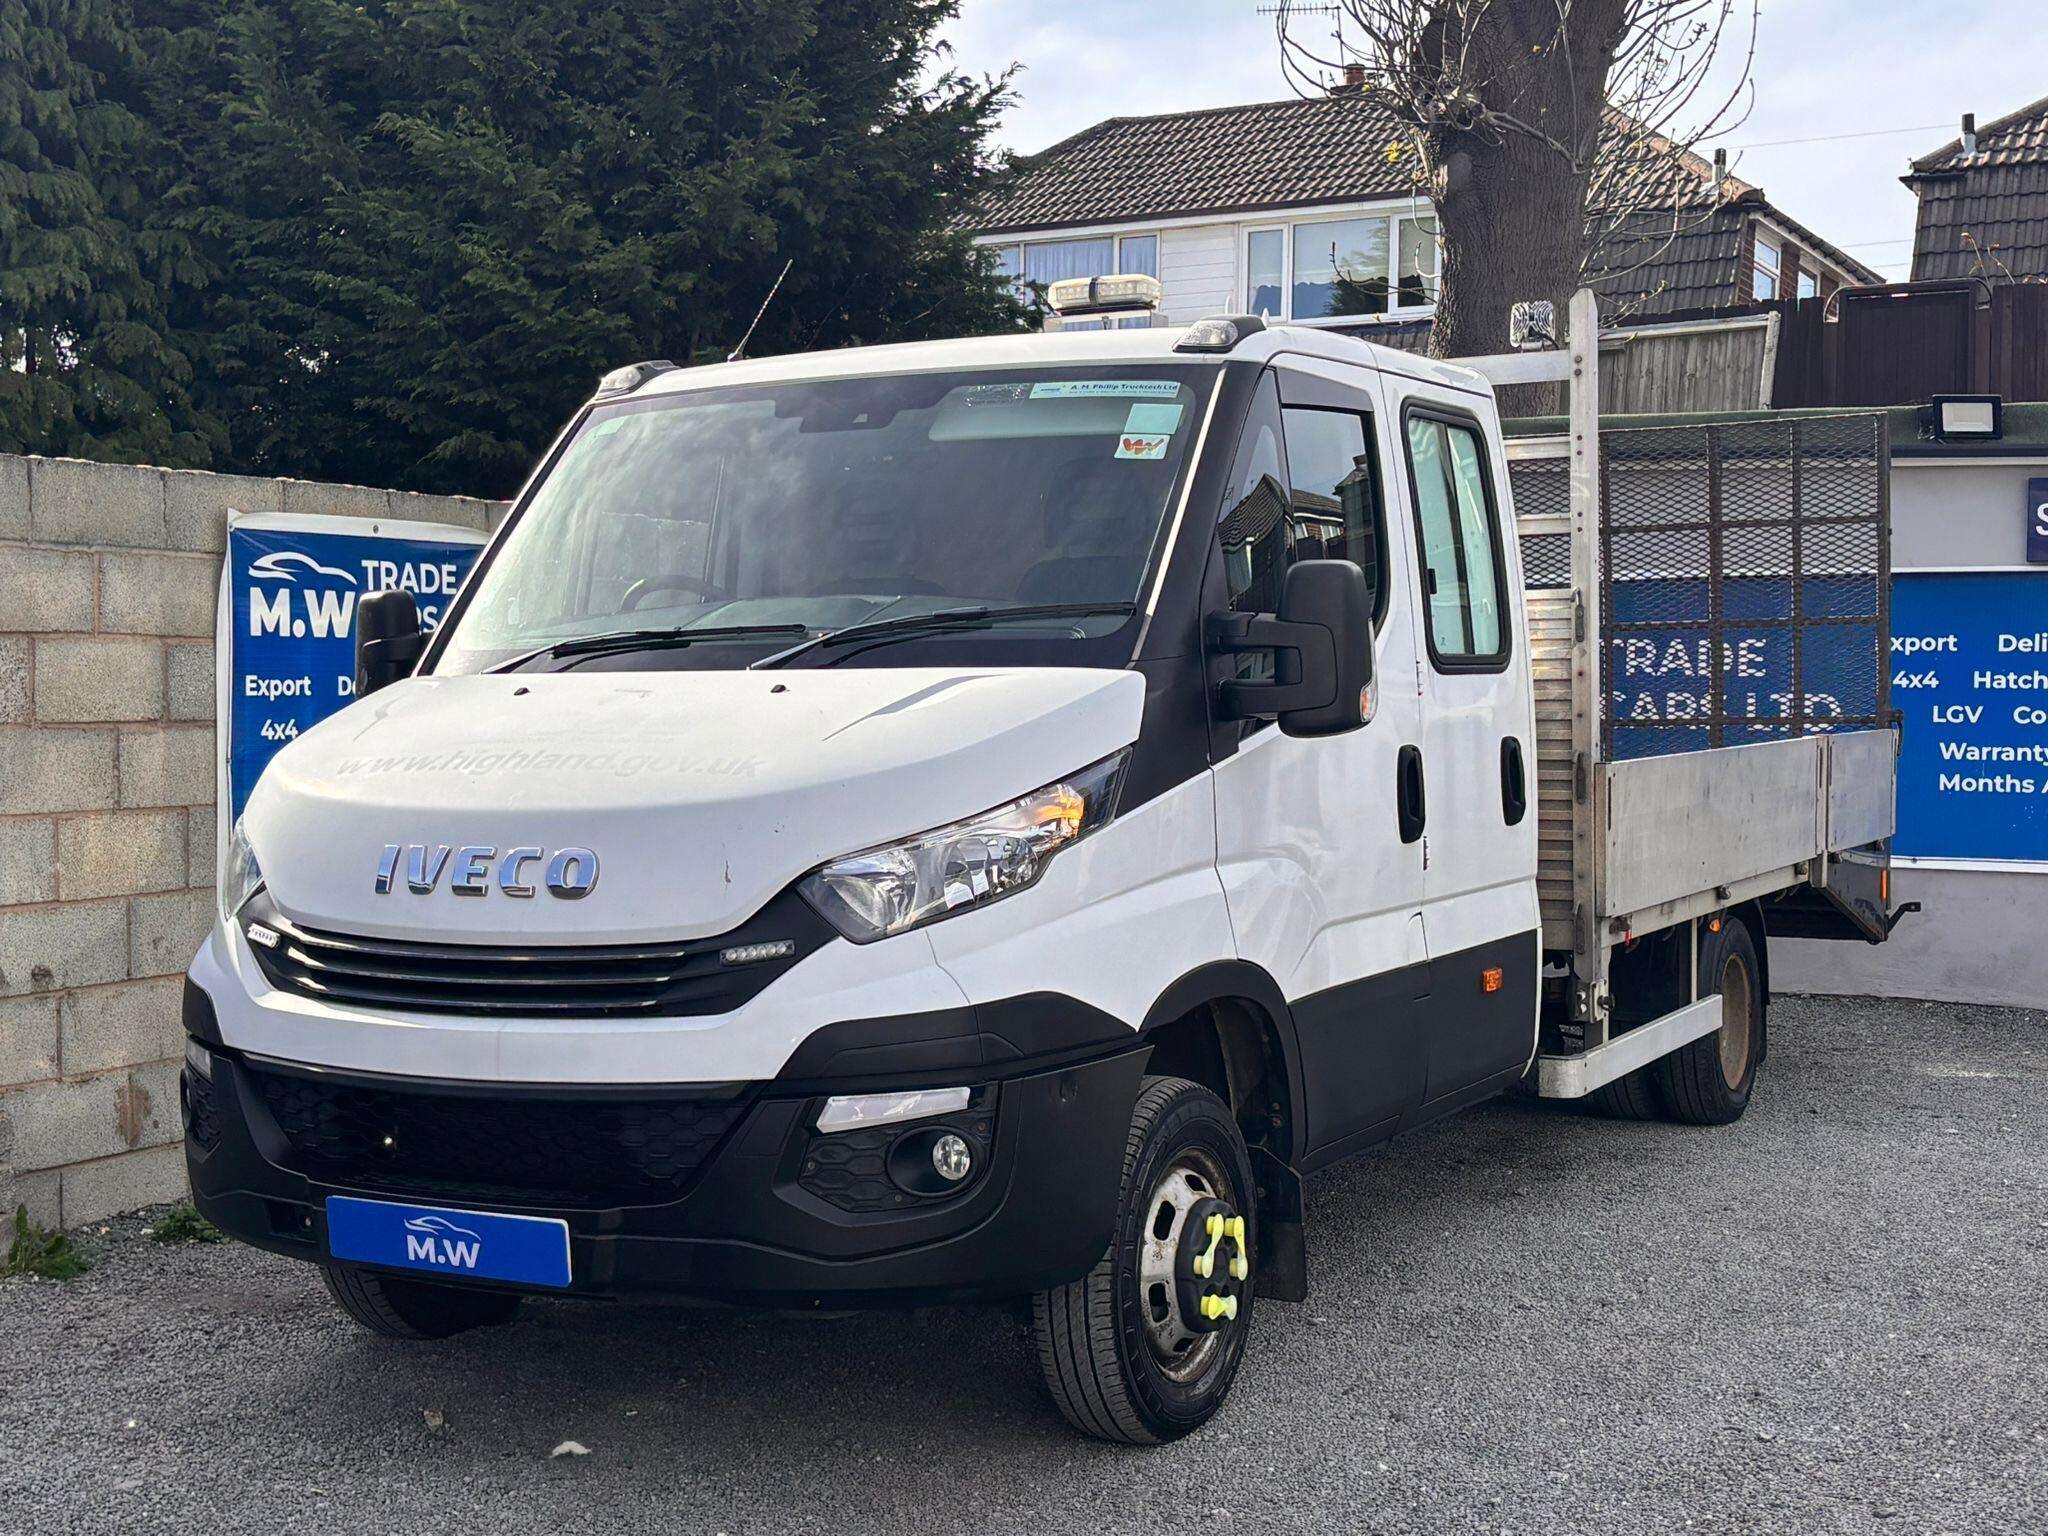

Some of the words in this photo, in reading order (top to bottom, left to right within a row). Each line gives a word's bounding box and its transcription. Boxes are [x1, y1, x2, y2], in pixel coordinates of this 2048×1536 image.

[361, 559, 458, 595] TRADE
[249, 586, 357, 638] M.W
[1890, 634, 1958, 656] xport
[1998, 632, 2048, 653] Deli
[245, 674, 312, 702] Export
[337, 675, 356, 697] D
[1892, 670, 1940, 689] 4x4
[1973, 670, 2048, 690] Hatch
[1932, 705, 1984, 724] LGV
[2013, 705, 2047, 725] Co
[260, 718, 299, 741] 4x4
[336, 750, 768, 777] www.highland.gov.uk
[1939, 773, 2035, 793] Months
[374, 843, 602, 901] IVECO
[406, 1235, 480, 1268] M.W
